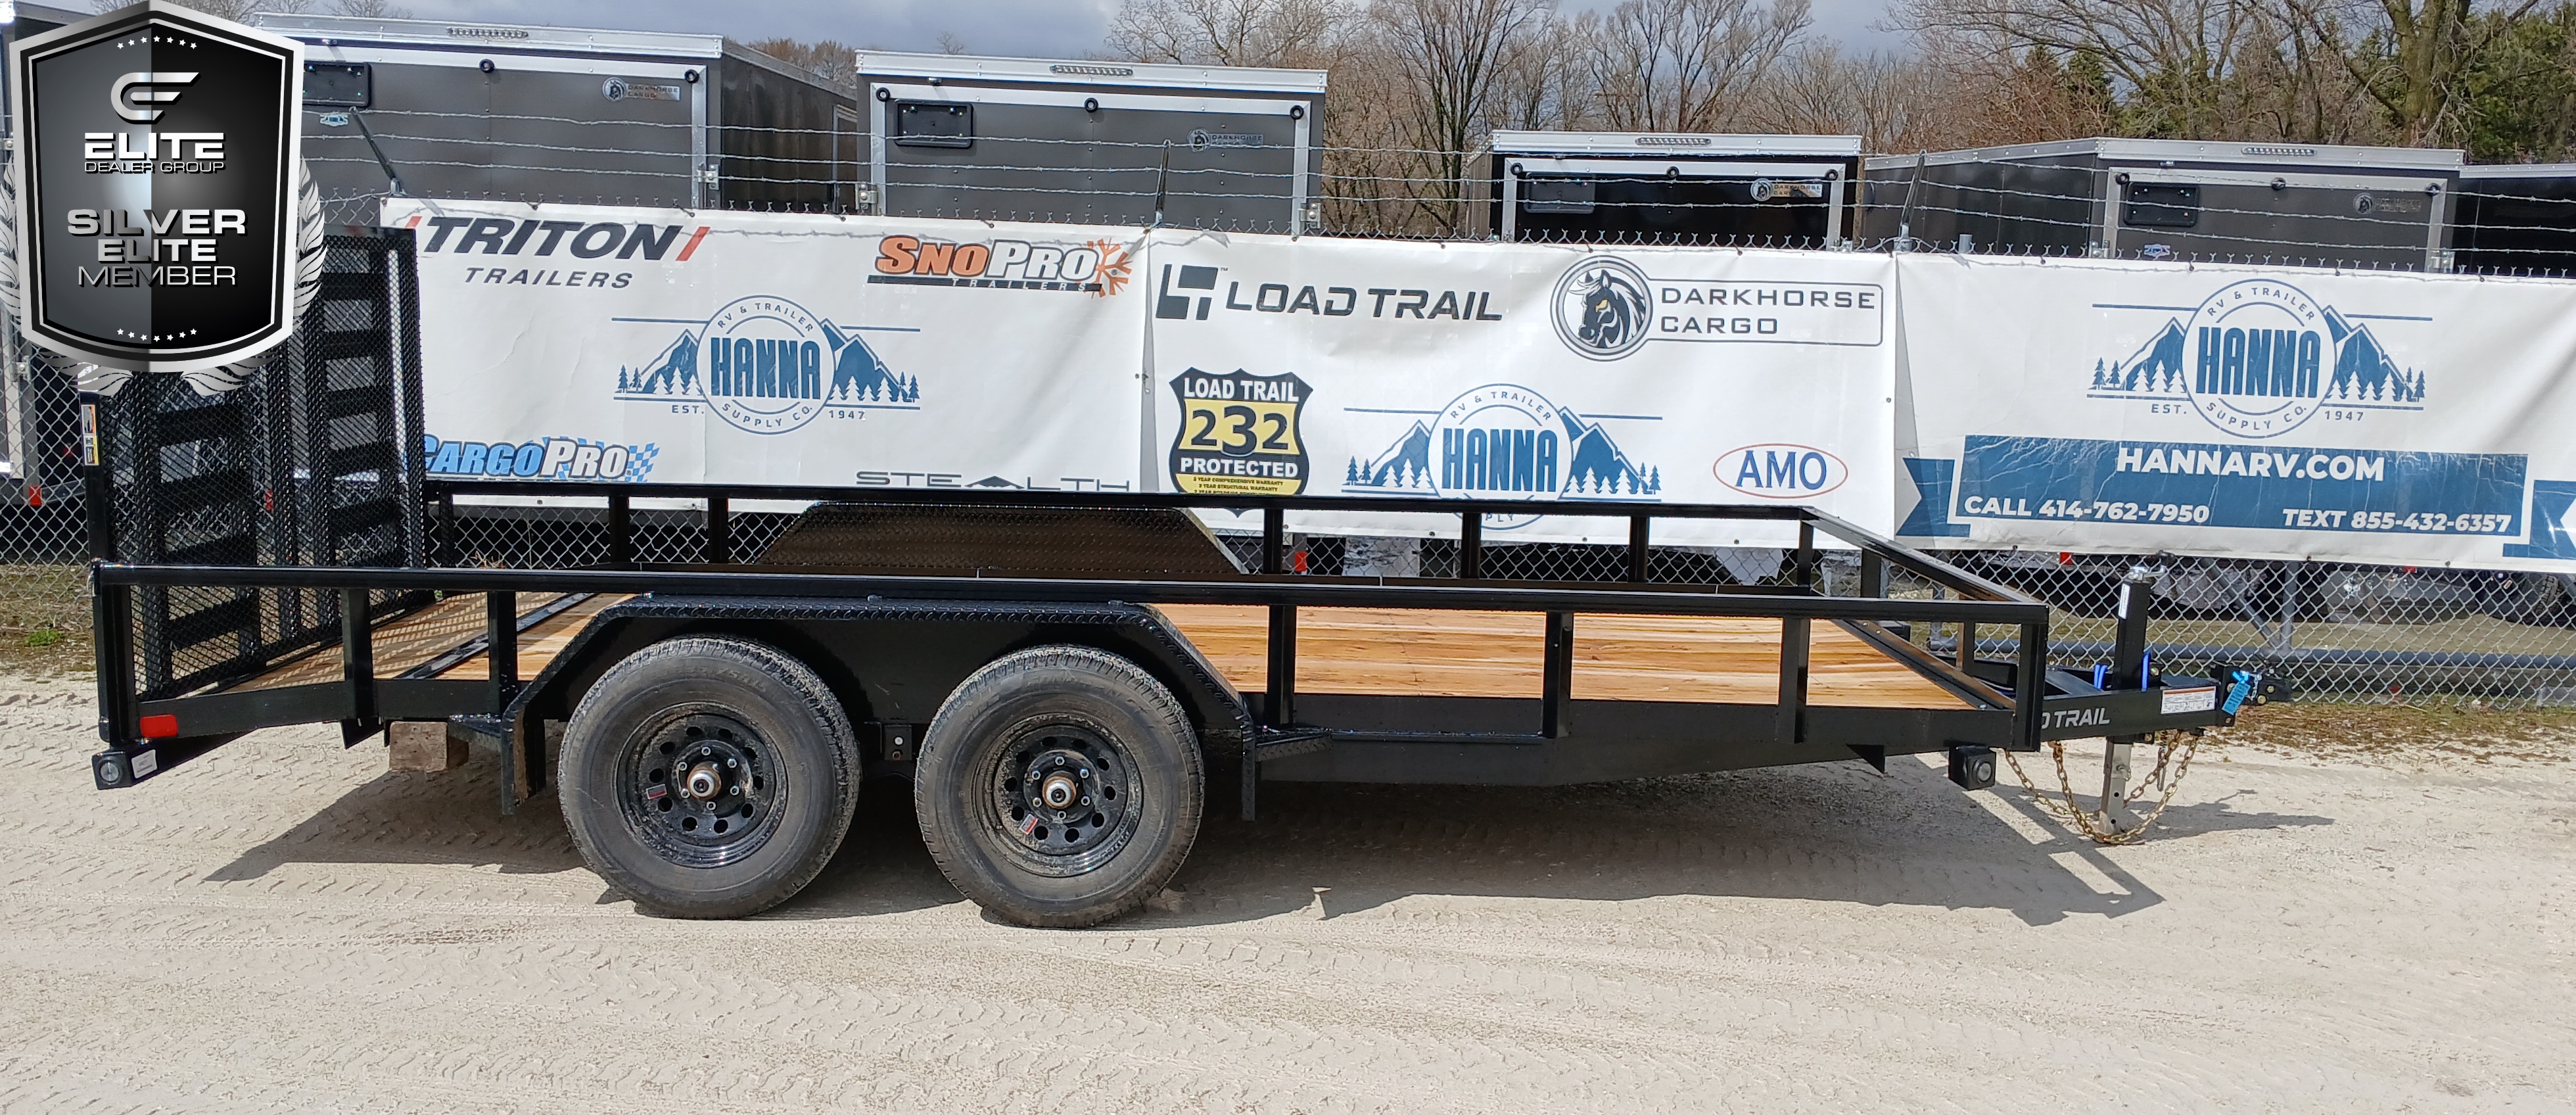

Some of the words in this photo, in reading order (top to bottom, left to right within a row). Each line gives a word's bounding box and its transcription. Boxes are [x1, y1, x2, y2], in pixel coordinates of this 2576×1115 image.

[423, 216, 684, 261] TRITON
[464, 267, 634, 289] TRAILERS
[951, 277, 1087, 292] TRAILERS
[1225, 281, 1357, 316] LOAD
[1367, 288, 1503, 321] TRAIL
[1661, 287, 1875, 309] DARKHORSE
[2207, 299, 2224, 317] RV
[2234, 291, 2243, 300] &
[2251, 287, 2315, 321] TRAILER
[717, 313, 733, 329] RV
[739, 306, 748, 314] &
[755, 302, 814, 332] TRAILER
[1661, 316, 1777, 335] CARGO
[711, 337, 820, 399] HANNA
[2195, 326, 2321, 398] HANNA
[1183, 377, 1235, 400] LOAD
[1240, 380, 1300, 402] TRAIL
[672, 405, 705, 415] EST.
[722, 403, 782, 427] SUPPLY
[793, 406, 813, 421] CO.
[829, 410, 866, 419] 1947
[1450, 403, 1466, 419] RV
[1490, 391, 1551, 421] TRAILER
[2151, 404, 2188, 415] EST.
[2206, 402, 2272, 431] SUPPLY
[2283, 405, 2307, 423] CO.
[2324, 411, 2364, 421] 1947
[1190, 405, 1289, 456] 232
[1180, 457, 1299, 478] PROTECTED
[1441, 427, 1558, 492] HANNA
[1735, 450, 1827, 490] AMO
[2116, 447, 2385, 482] HANNARV.COM
[856, 471, 1131, 492] STEALTH
[1964, 495, 2032, 517] CALL
[2038, 499, 2211, 524] 414-762-7950
[2282, 508, 2347, 527] TEXT
[2351, 511, 2512, 533] 855-432-6357
[2053, 707, 2111, 728] TRAIL
